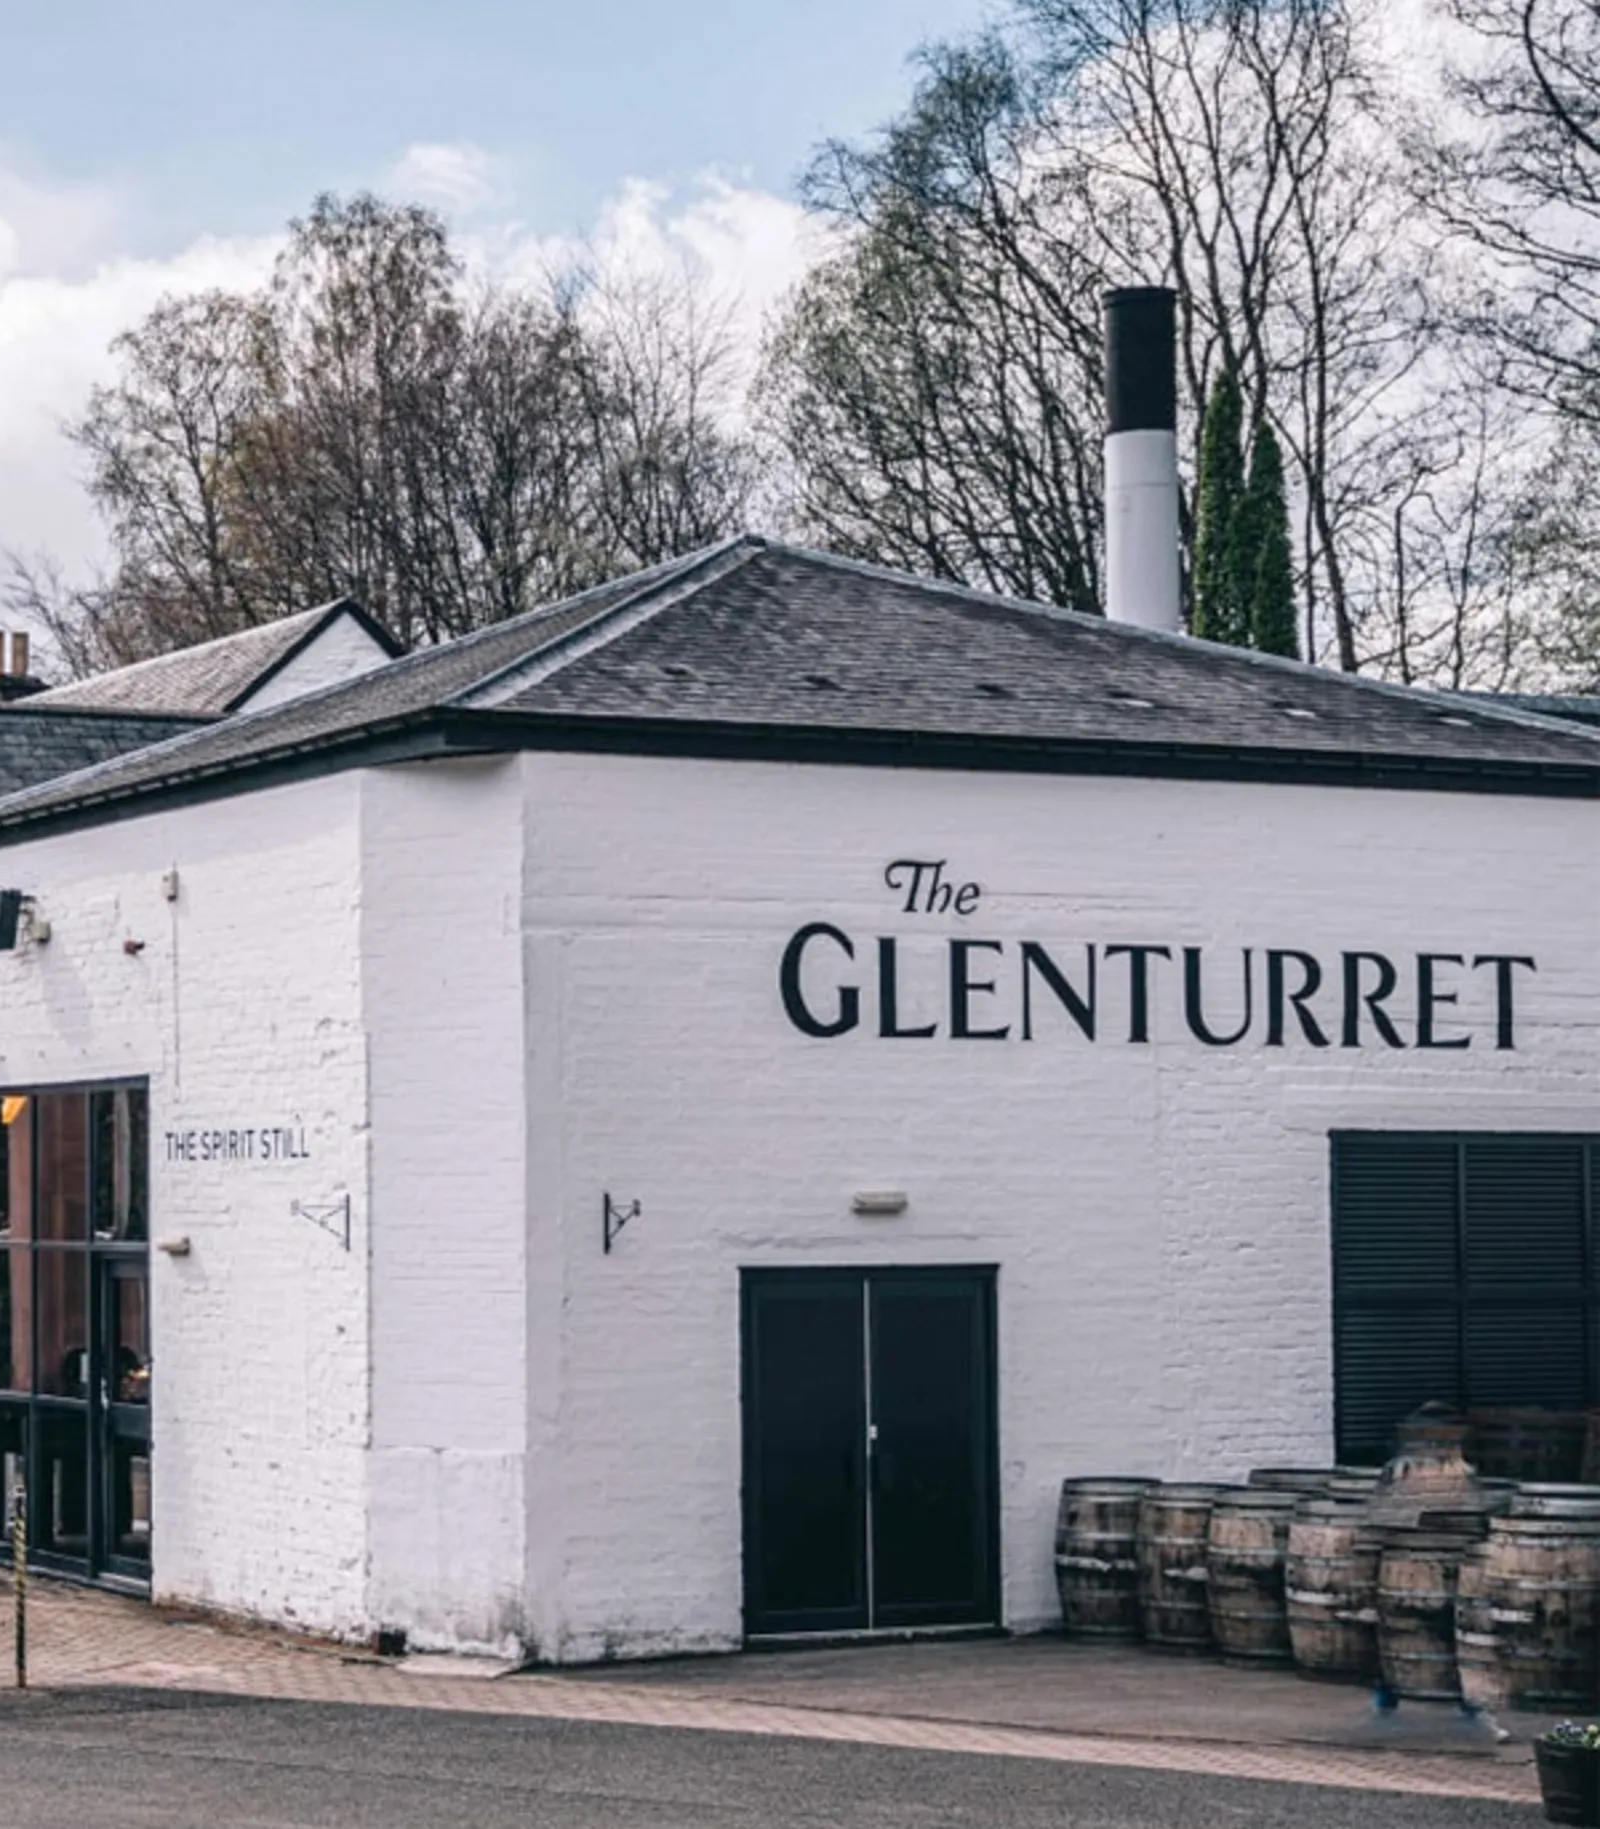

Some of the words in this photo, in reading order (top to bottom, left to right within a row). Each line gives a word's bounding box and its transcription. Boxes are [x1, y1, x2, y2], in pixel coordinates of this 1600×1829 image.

[884, 858, 981, 915] The
[779, 921, 1537, 1051] GLENTURRET
[164, 1131, 197, 1161] THE
[200, 1128, 256, 1161] SPIRIT
[260, 1126, 310, 1160] STILL
